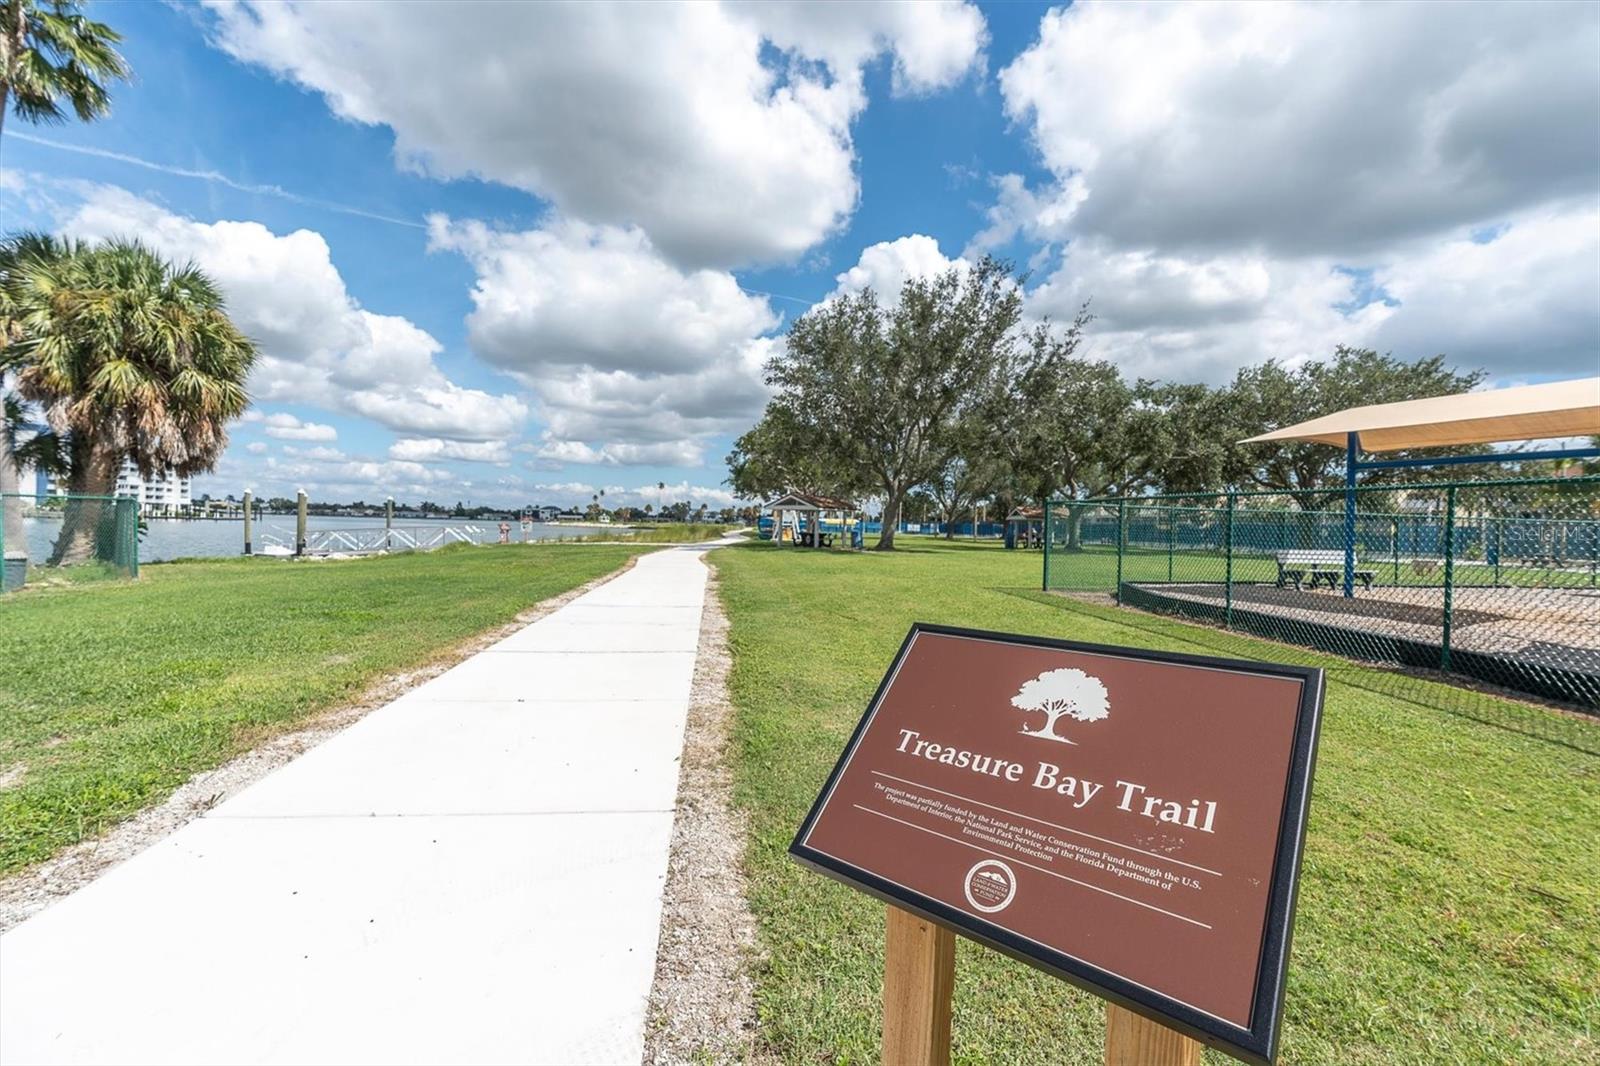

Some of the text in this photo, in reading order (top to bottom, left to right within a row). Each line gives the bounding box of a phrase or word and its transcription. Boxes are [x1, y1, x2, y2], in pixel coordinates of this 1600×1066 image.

[896, 729, 1217, 834] Treasure Bay Trail
[874, 782, 1202, 890] The project was partially funded by the Land and Water Conservation Fund through the U.S.
[886, 793, 1173, 891] Department of Interior, the National Park Service, and the Florida Department of
[962, 826, 1053, 862] Environmental Protection
